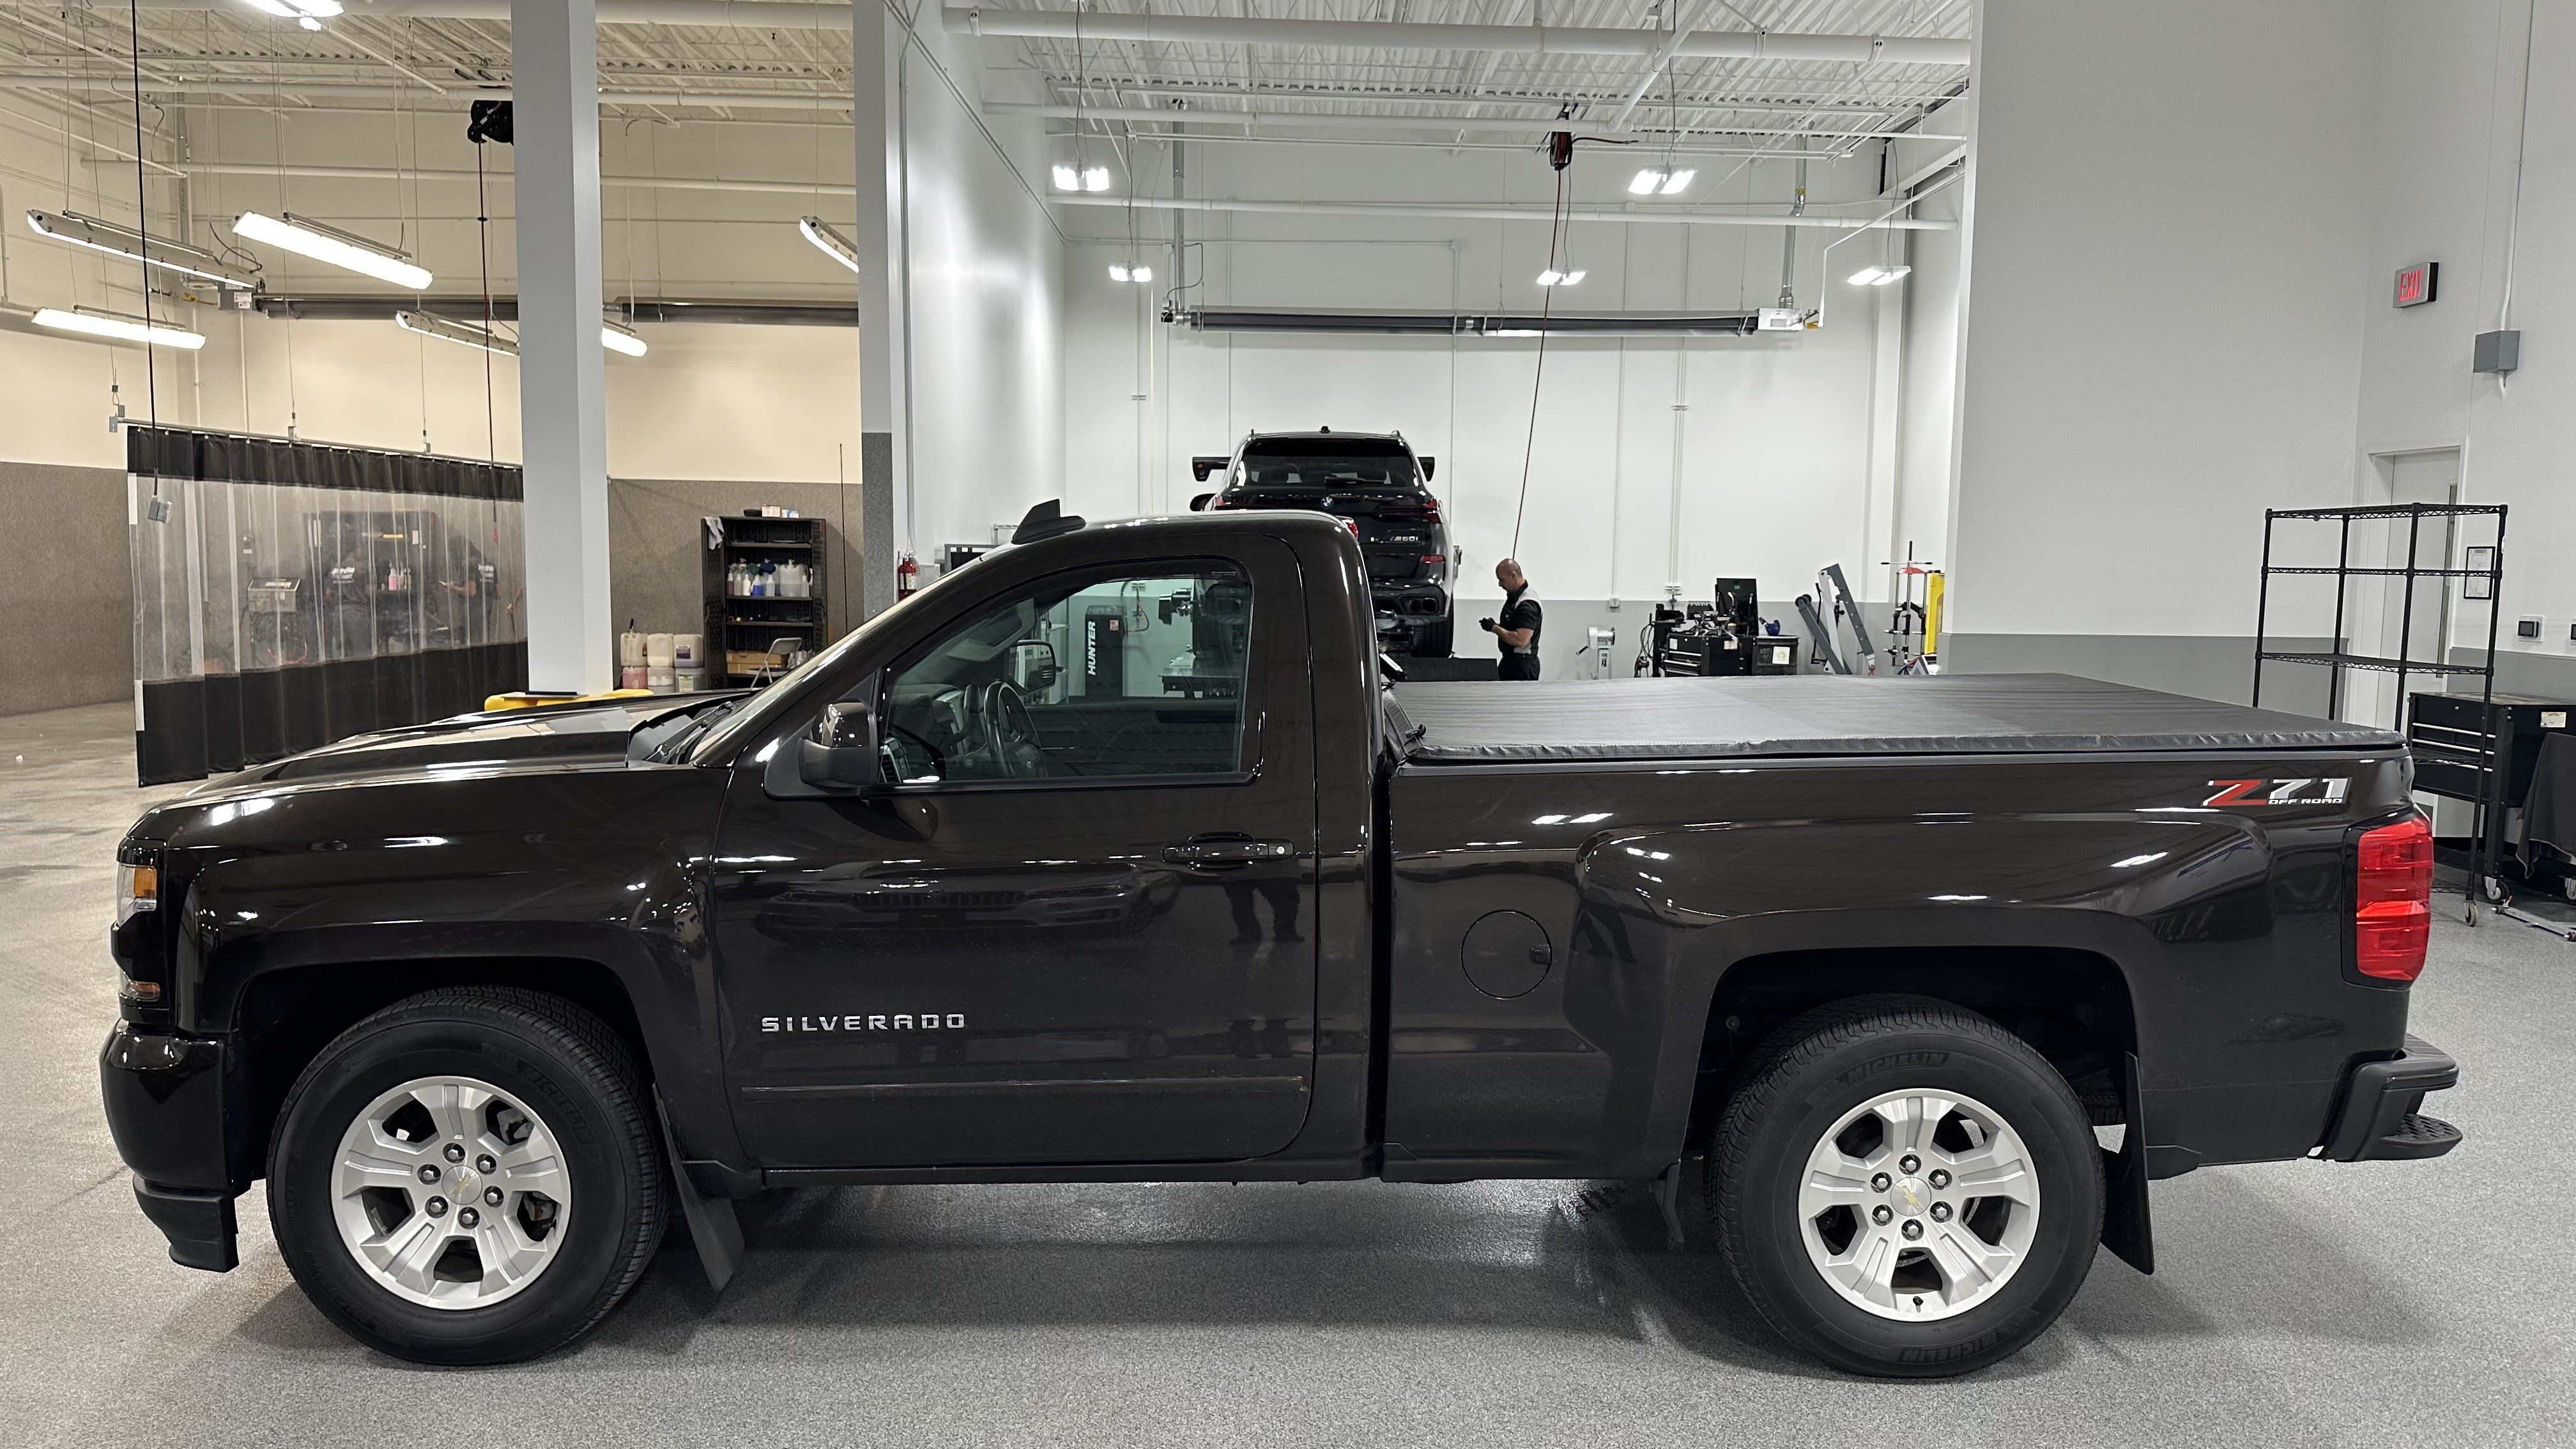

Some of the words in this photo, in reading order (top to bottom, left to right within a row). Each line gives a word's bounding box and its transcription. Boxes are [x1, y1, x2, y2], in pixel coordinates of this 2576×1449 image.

[2400, 270, 2423, 301] EXIT
[1087, 620, 1096, 676] HUNTER
[2202, 778, 2349, 806] Z71
[762, 1013, 965, 1032] SILVERADO
[1846, 1054, 1947, 1083] MICHELIN
[1901, 1330, 1997, 1362] MICHELIN
